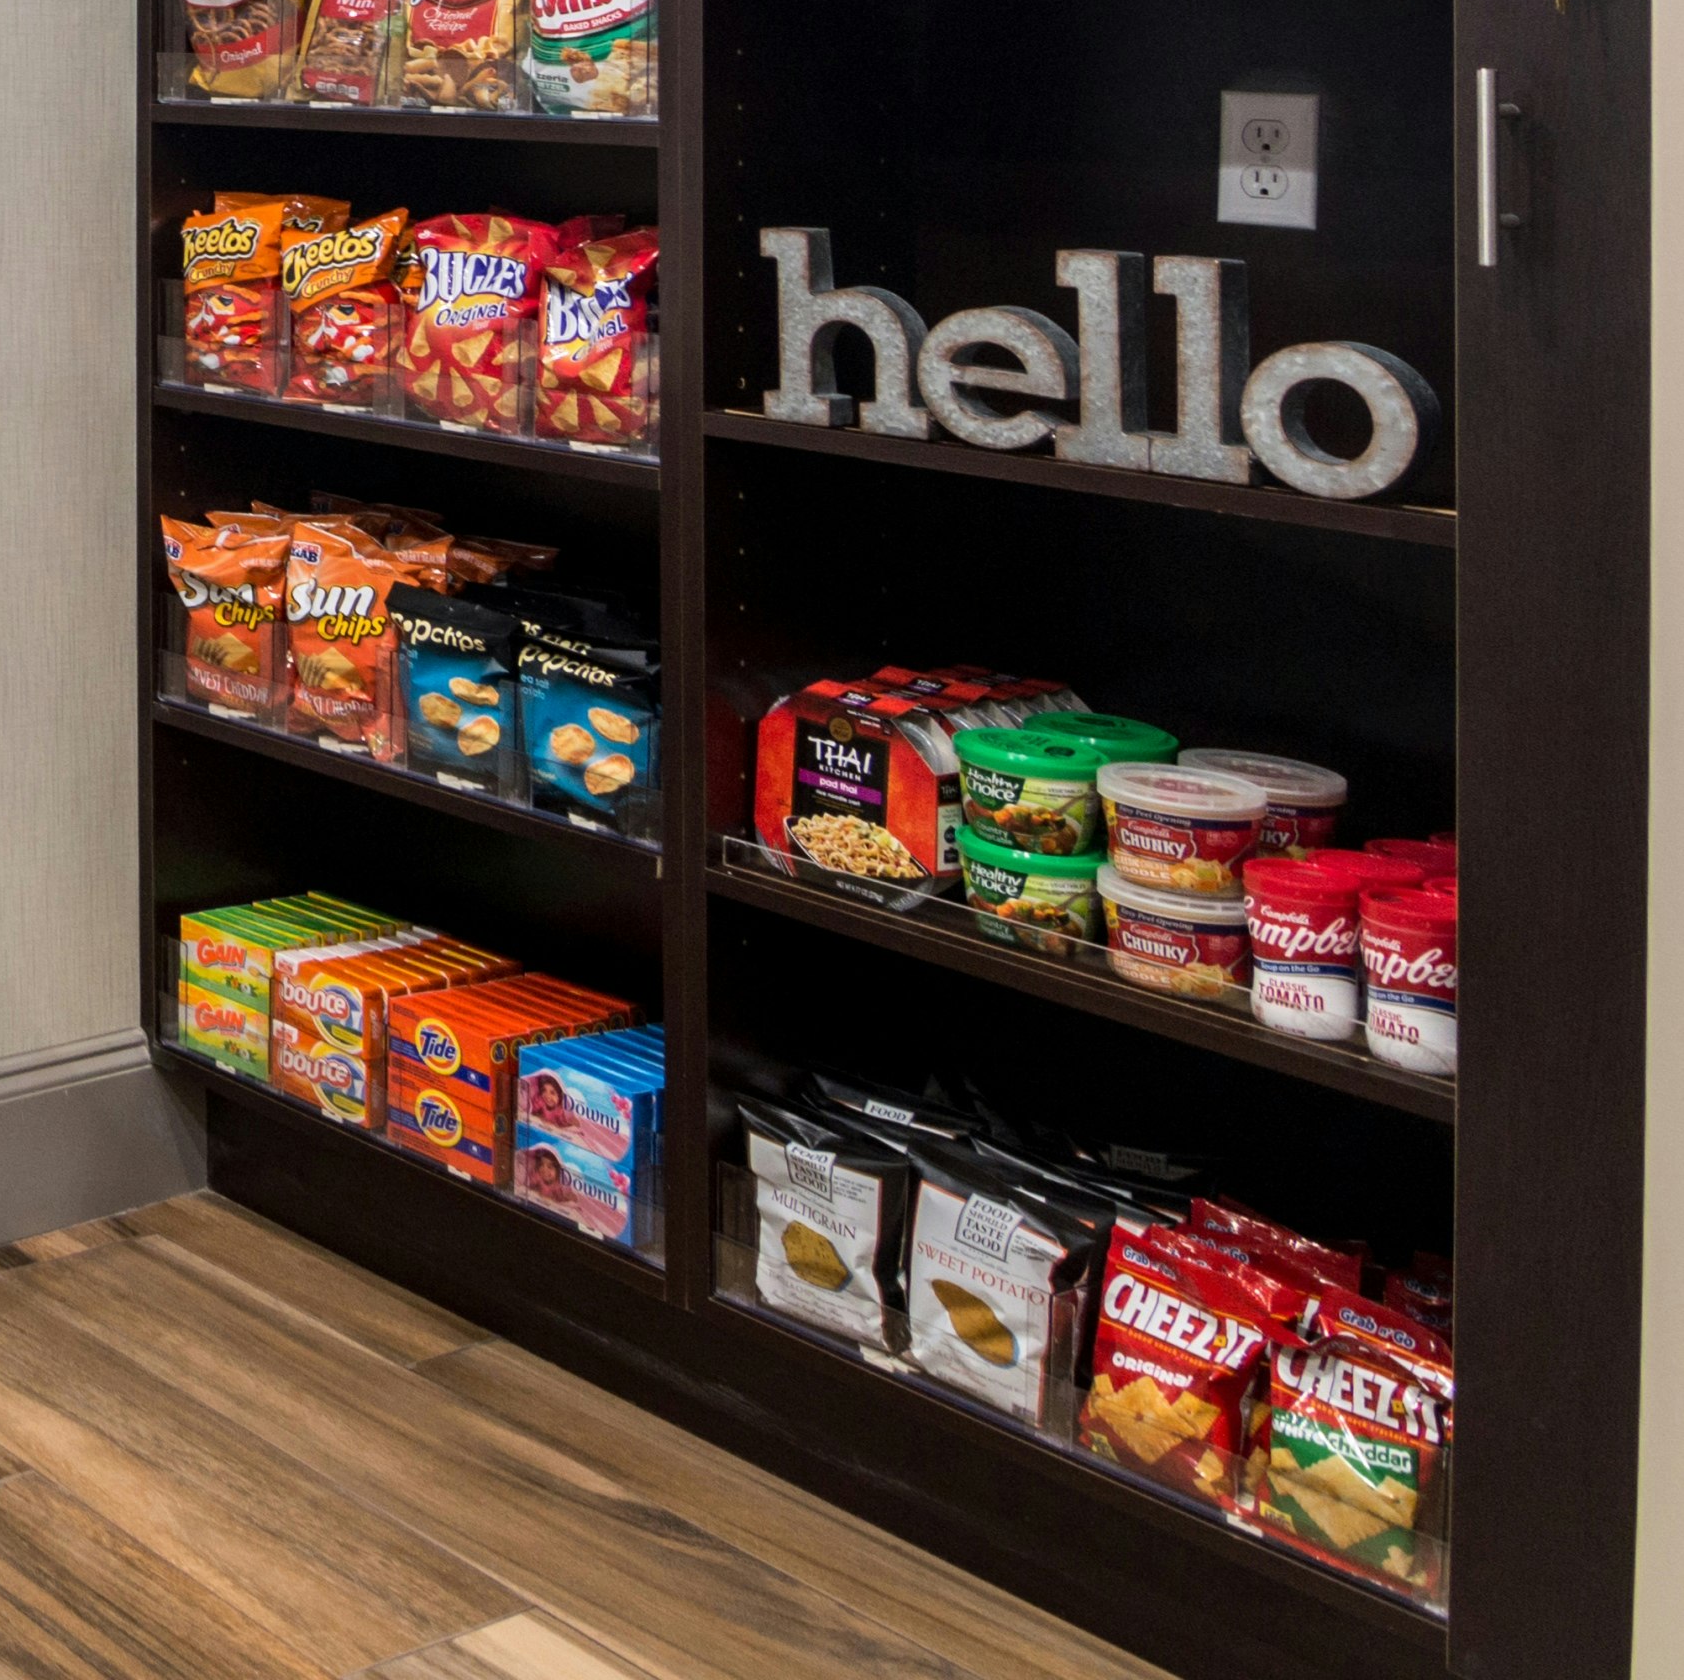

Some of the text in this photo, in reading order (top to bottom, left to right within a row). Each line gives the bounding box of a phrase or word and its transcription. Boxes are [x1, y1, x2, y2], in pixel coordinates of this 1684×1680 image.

[563, 10, 623, 32] BAKED SNACKS
[220, 42, 263, 63] Original
[183, 225, 254, 268] heetos
[188, 262, 235, 282] Crunchy
[283, 230, 375, 294] Cheetos
[301, 268, 353, 297] Crunchy
[418, 247, 526, 312] BUGLES
[760, 226, 1441, 500] hello
[179, 571, 254, 608] Sun
[287, 577, 376, 621] Sun
[214, 602, 275, 630] Chips
[317, 615, 387, 645] Chips
[518, 645, 617, 688] popchips
[808, 735, 872, 775] THAI
[819, 764, 862, 782] KITCHEN
[819, 777, 858, 795] pad thai
[969, 767, 1019, 790] Healthy
[965, 777, 1016, 803] Choice
[1120, 829, 1187, 858] CHUNKY
[969, 871, 1019, 897] Choice
[971, 861, 1022, 886] Healthy
[1261, 904, 1310, 925] Campbell's
[196, 937, 246, 967] GAIN
[1121, 930, 1188, 963] CHUNKY
[1291, 964, 1305, 972] the
[1307, 964, 1320, 973] Go
[281, 977, 348, 1014] bounce
[1258, 982, 1325, 1012] TOMATO
[1269, 978, 1307, 994] CLASSIC
[195, 1001, 245, 1030] GAIN
[420, 1030, 456, 1060] Tide
[281, 1045, 349, 1082] bounce
[420, 1101, 458, 1132] Tide
[562, 1093, 620, 1134] Downy
[870, 1104, 907, 1122] FOOD
[791, 1145, 829, 1164] FOOD
[792, 1162, 826, 1183] TASTE
[795, 1173, 828, 1194] GOOD
[560, 1169, 618, 1210] Downy
[771, 1189, 856, 1240] MULTIGRAIN
[968, 1208, 1008, 1231] SHOULD
[972, 1199, 1014, 1223] FOOD
[962, 1228, 1001, 1253] GOOD
[966, 1217, 1004, 1240] TASTE
[1123, 1246, 1150, 1266] Grab
[916, 1241, 1046, 1306] SWEET POTATO
[1339, 1308, 1416, 1349] Grab Go
